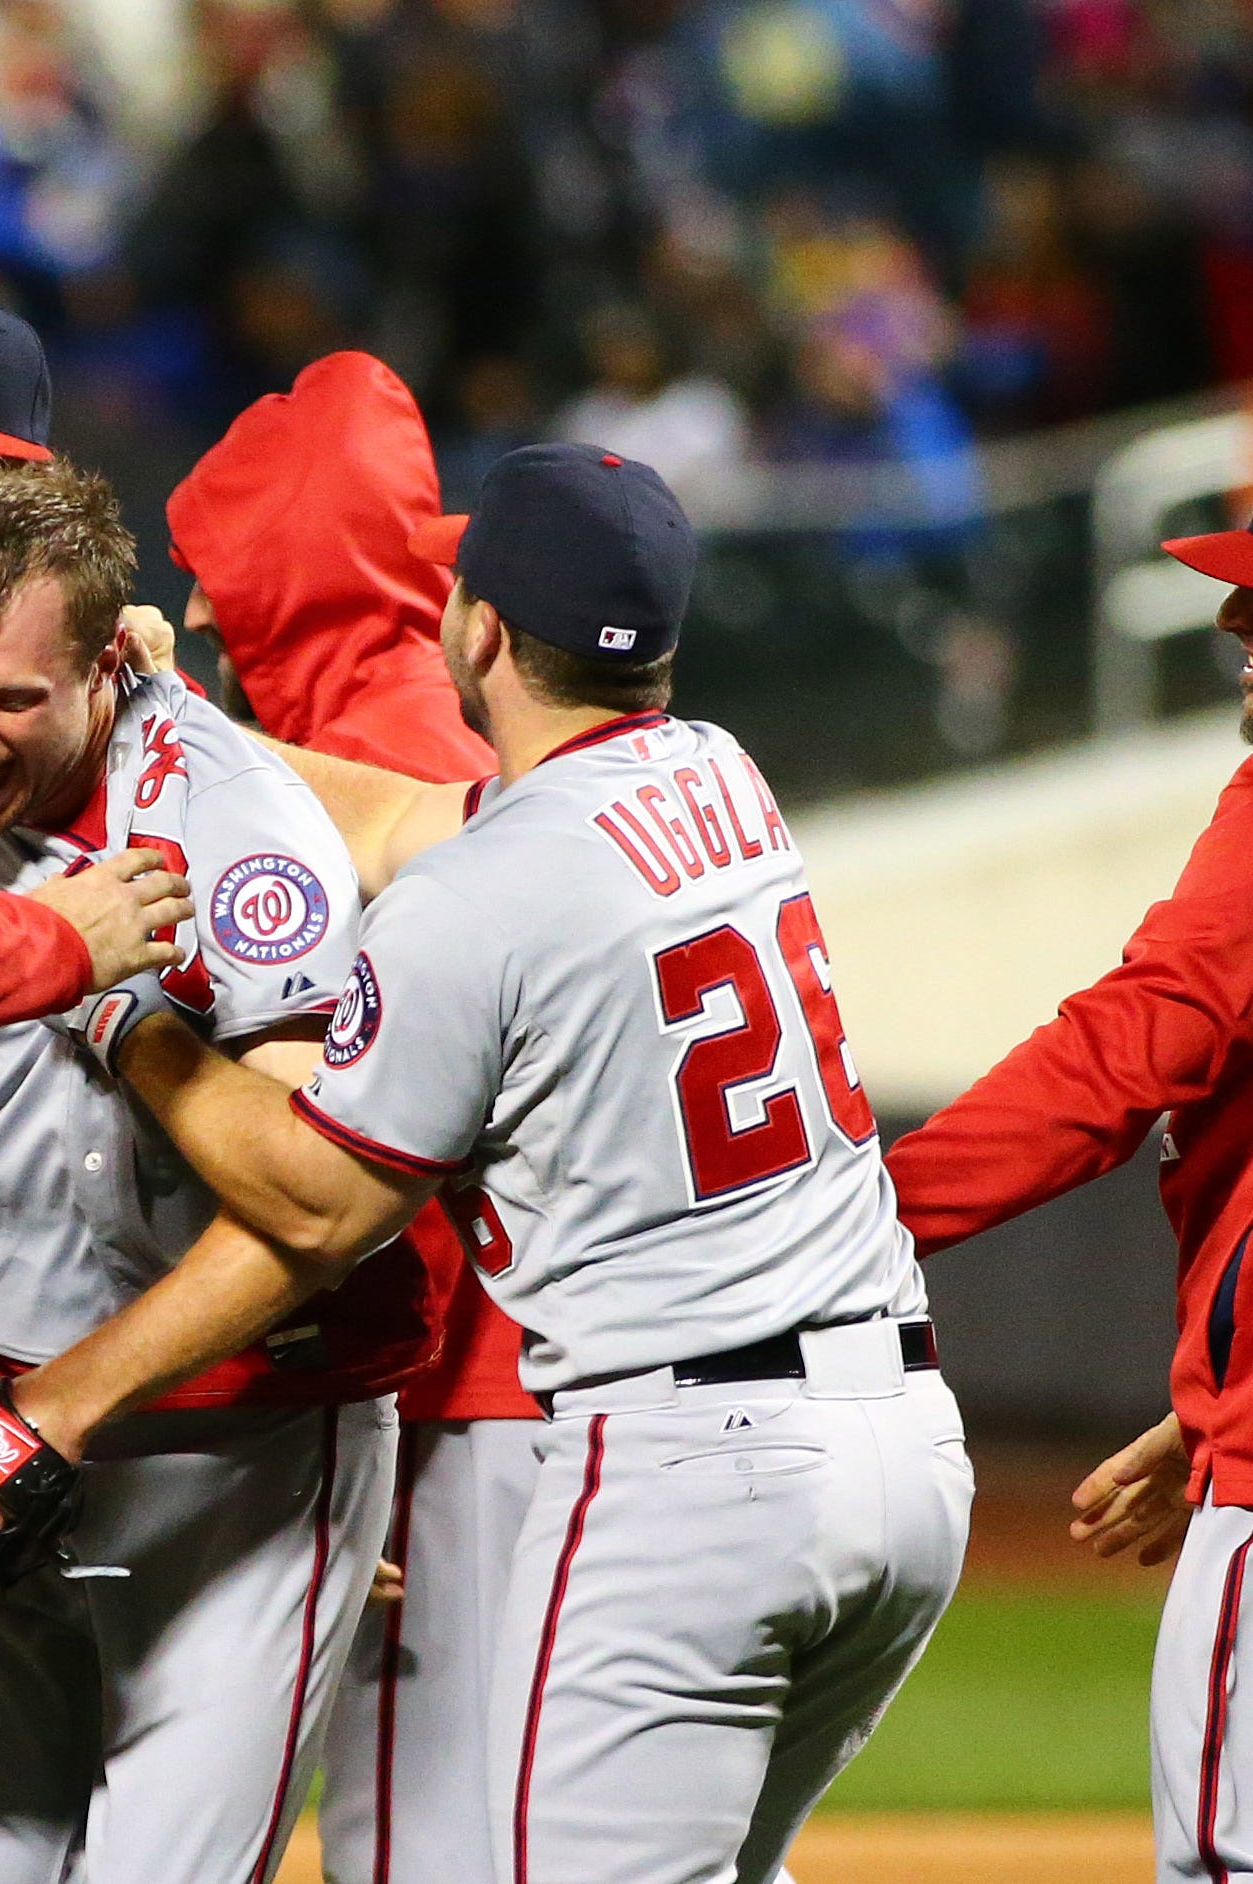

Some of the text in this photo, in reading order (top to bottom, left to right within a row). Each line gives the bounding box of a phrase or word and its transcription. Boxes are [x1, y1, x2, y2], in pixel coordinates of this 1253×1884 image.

[589, 752, 793, 899] UGGLA
[214, 857, 314, 919] WASHINGTON
[234, 911, 324, 959] NATIONALS
